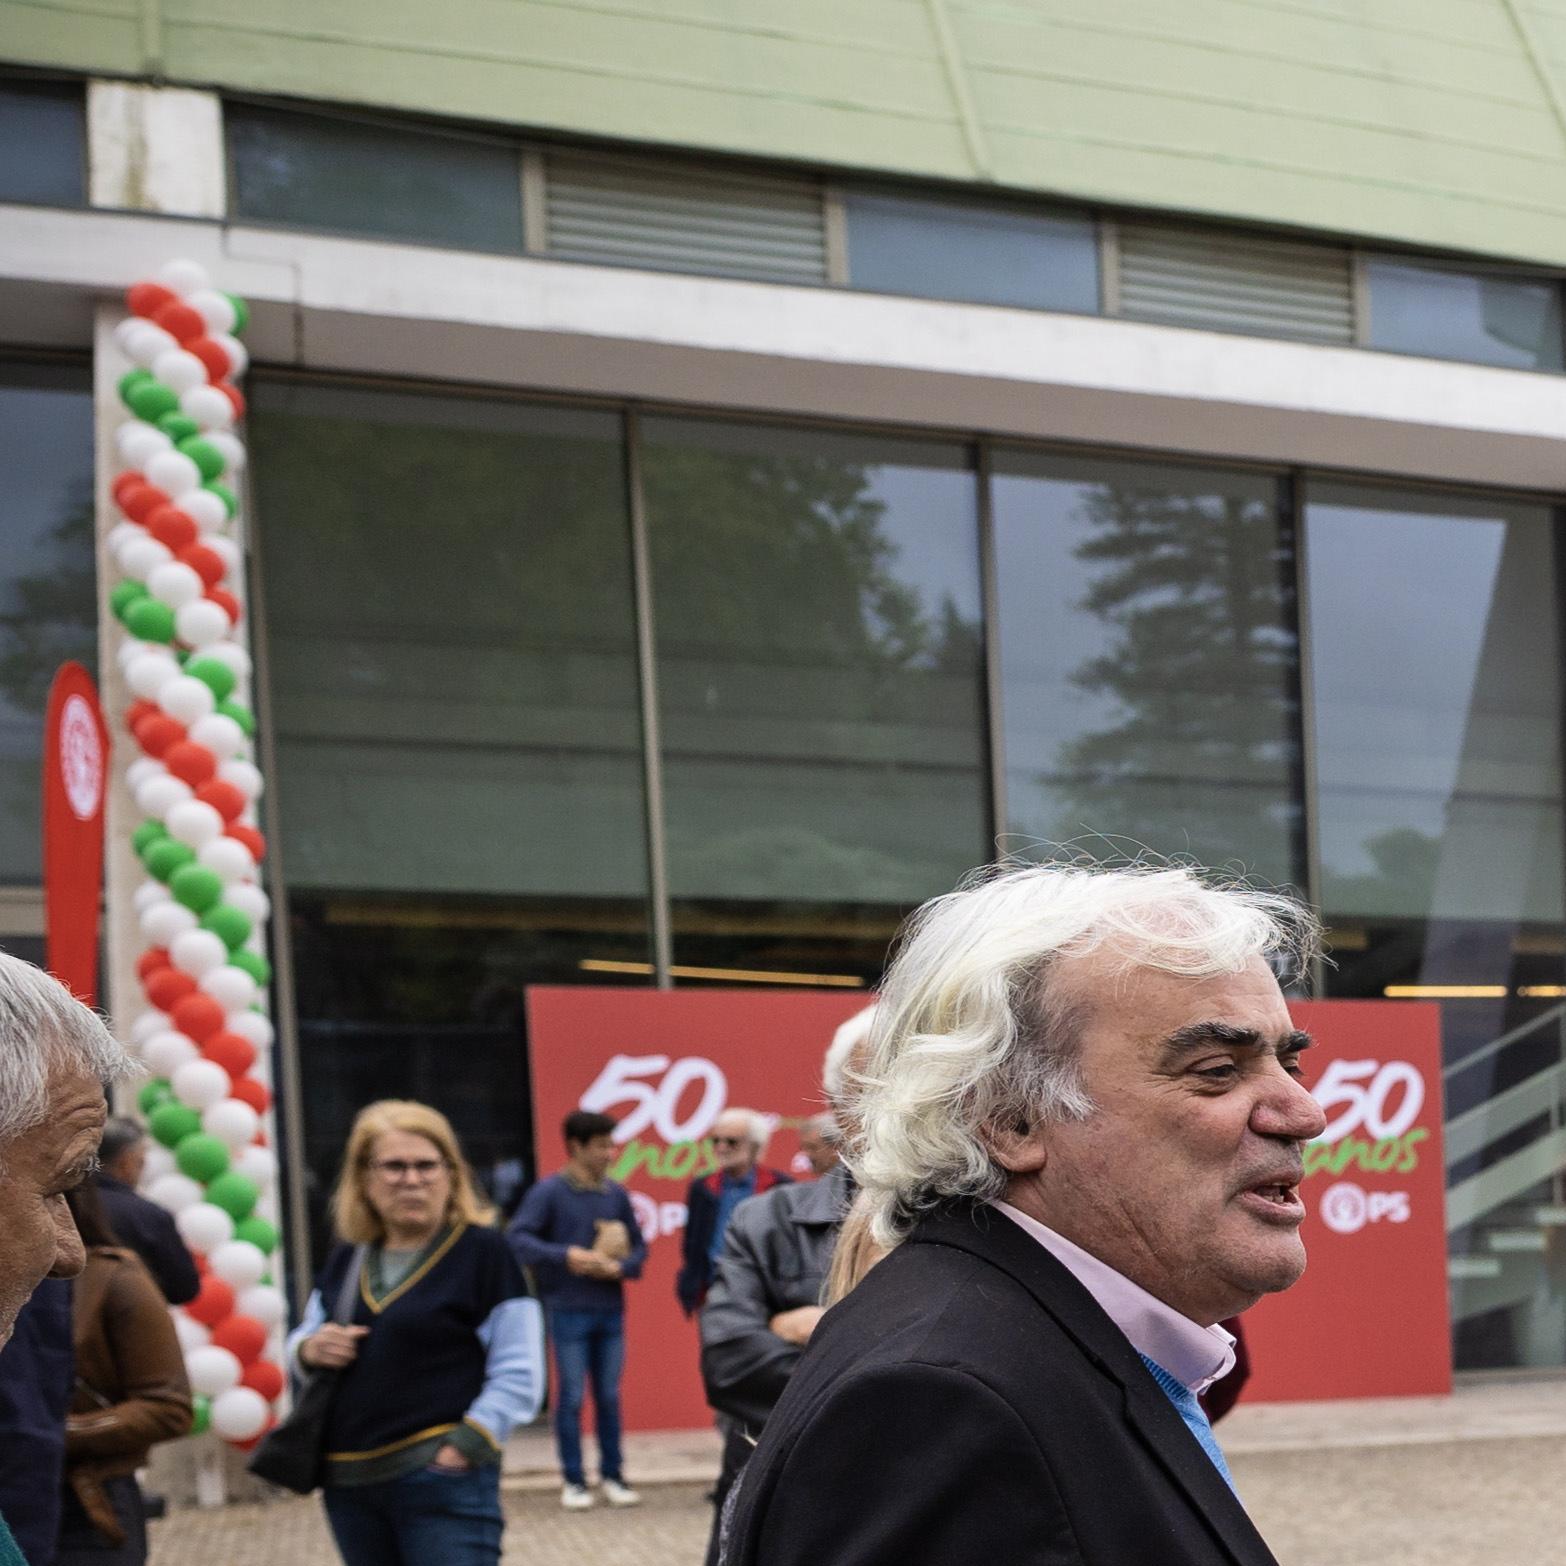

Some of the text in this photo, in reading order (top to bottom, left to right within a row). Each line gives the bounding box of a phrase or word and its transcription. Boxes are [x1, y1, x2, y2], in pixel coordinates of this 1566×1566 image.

[578, 1053, 728, 1146] 50
[1308, 1058, 1425, 1144] 50
[606, 1137, 721, 1182] nos
[1366, 1190, 1411, 1224] PS
